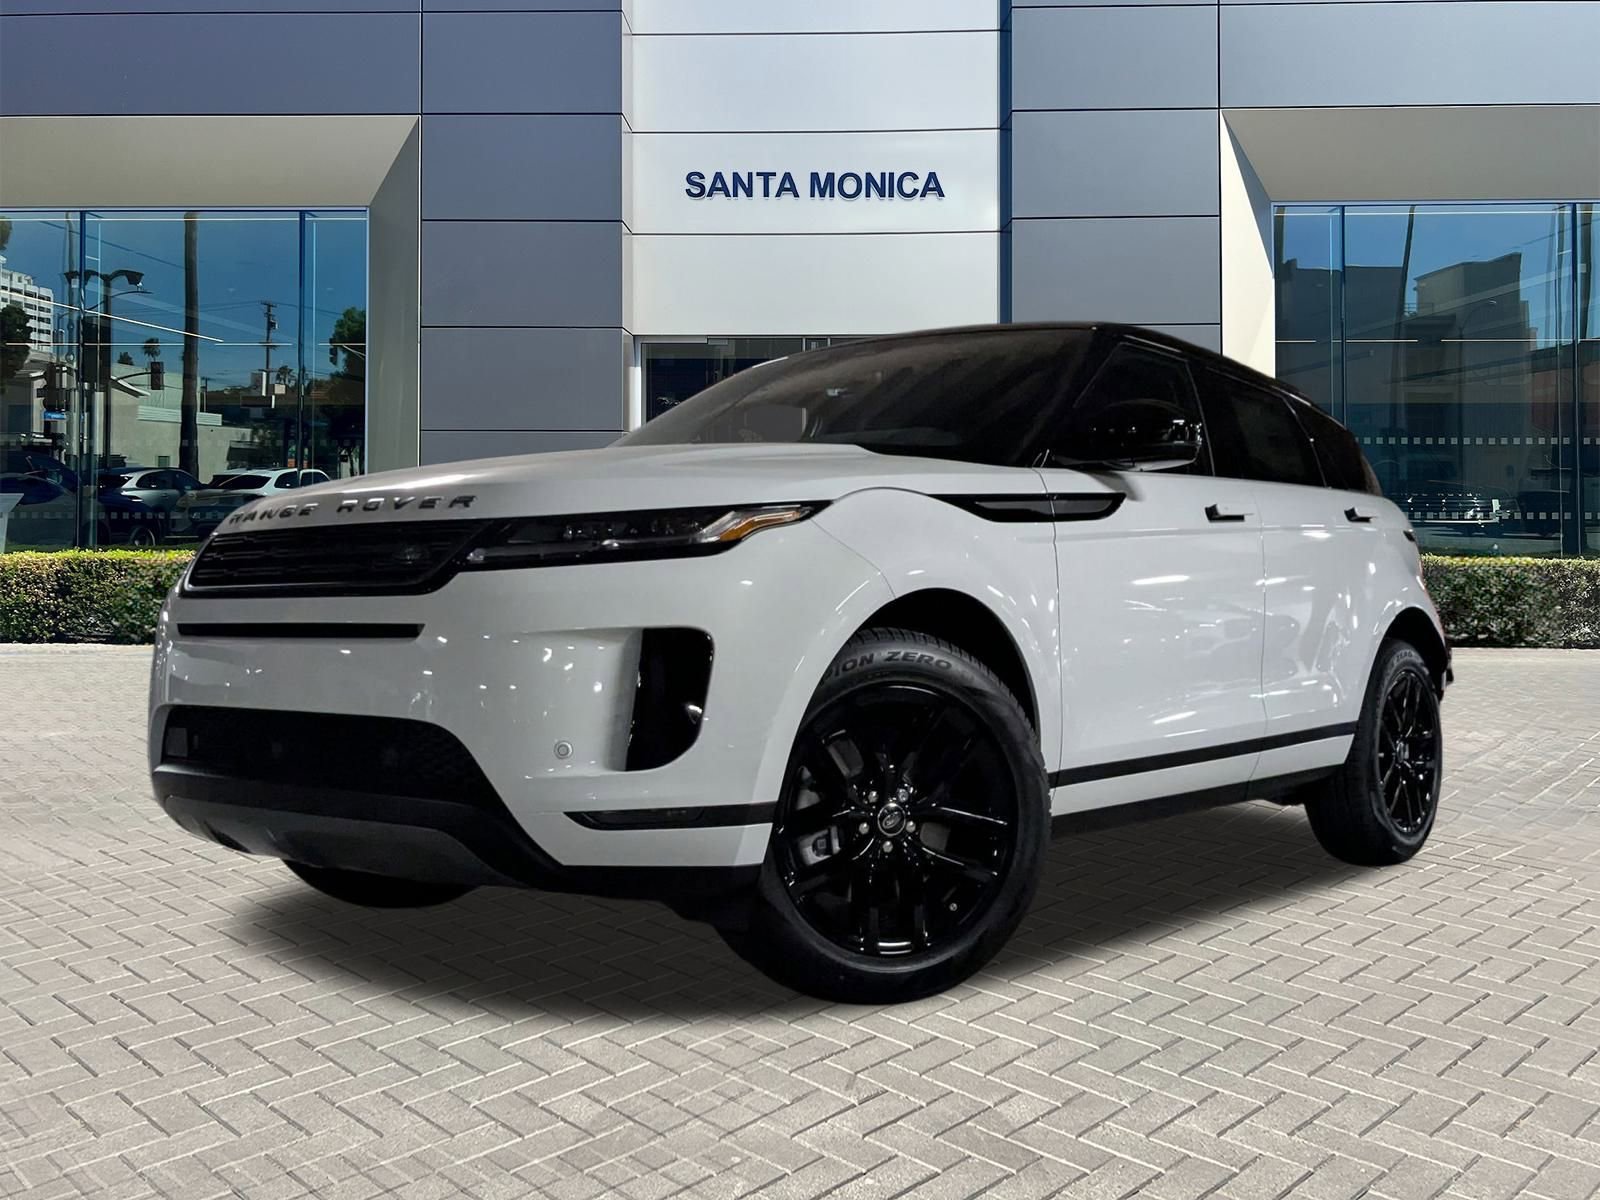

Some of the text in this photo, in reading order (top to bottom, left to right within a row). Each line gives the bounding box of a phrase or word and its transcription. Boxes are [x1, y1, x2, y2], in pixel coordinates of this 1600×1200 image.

[685, 171, 945, 199] SANTA MONICA
[229, 495, 477, 524] RANGE ROVER
[884, 651, 952, 670] ZERO
